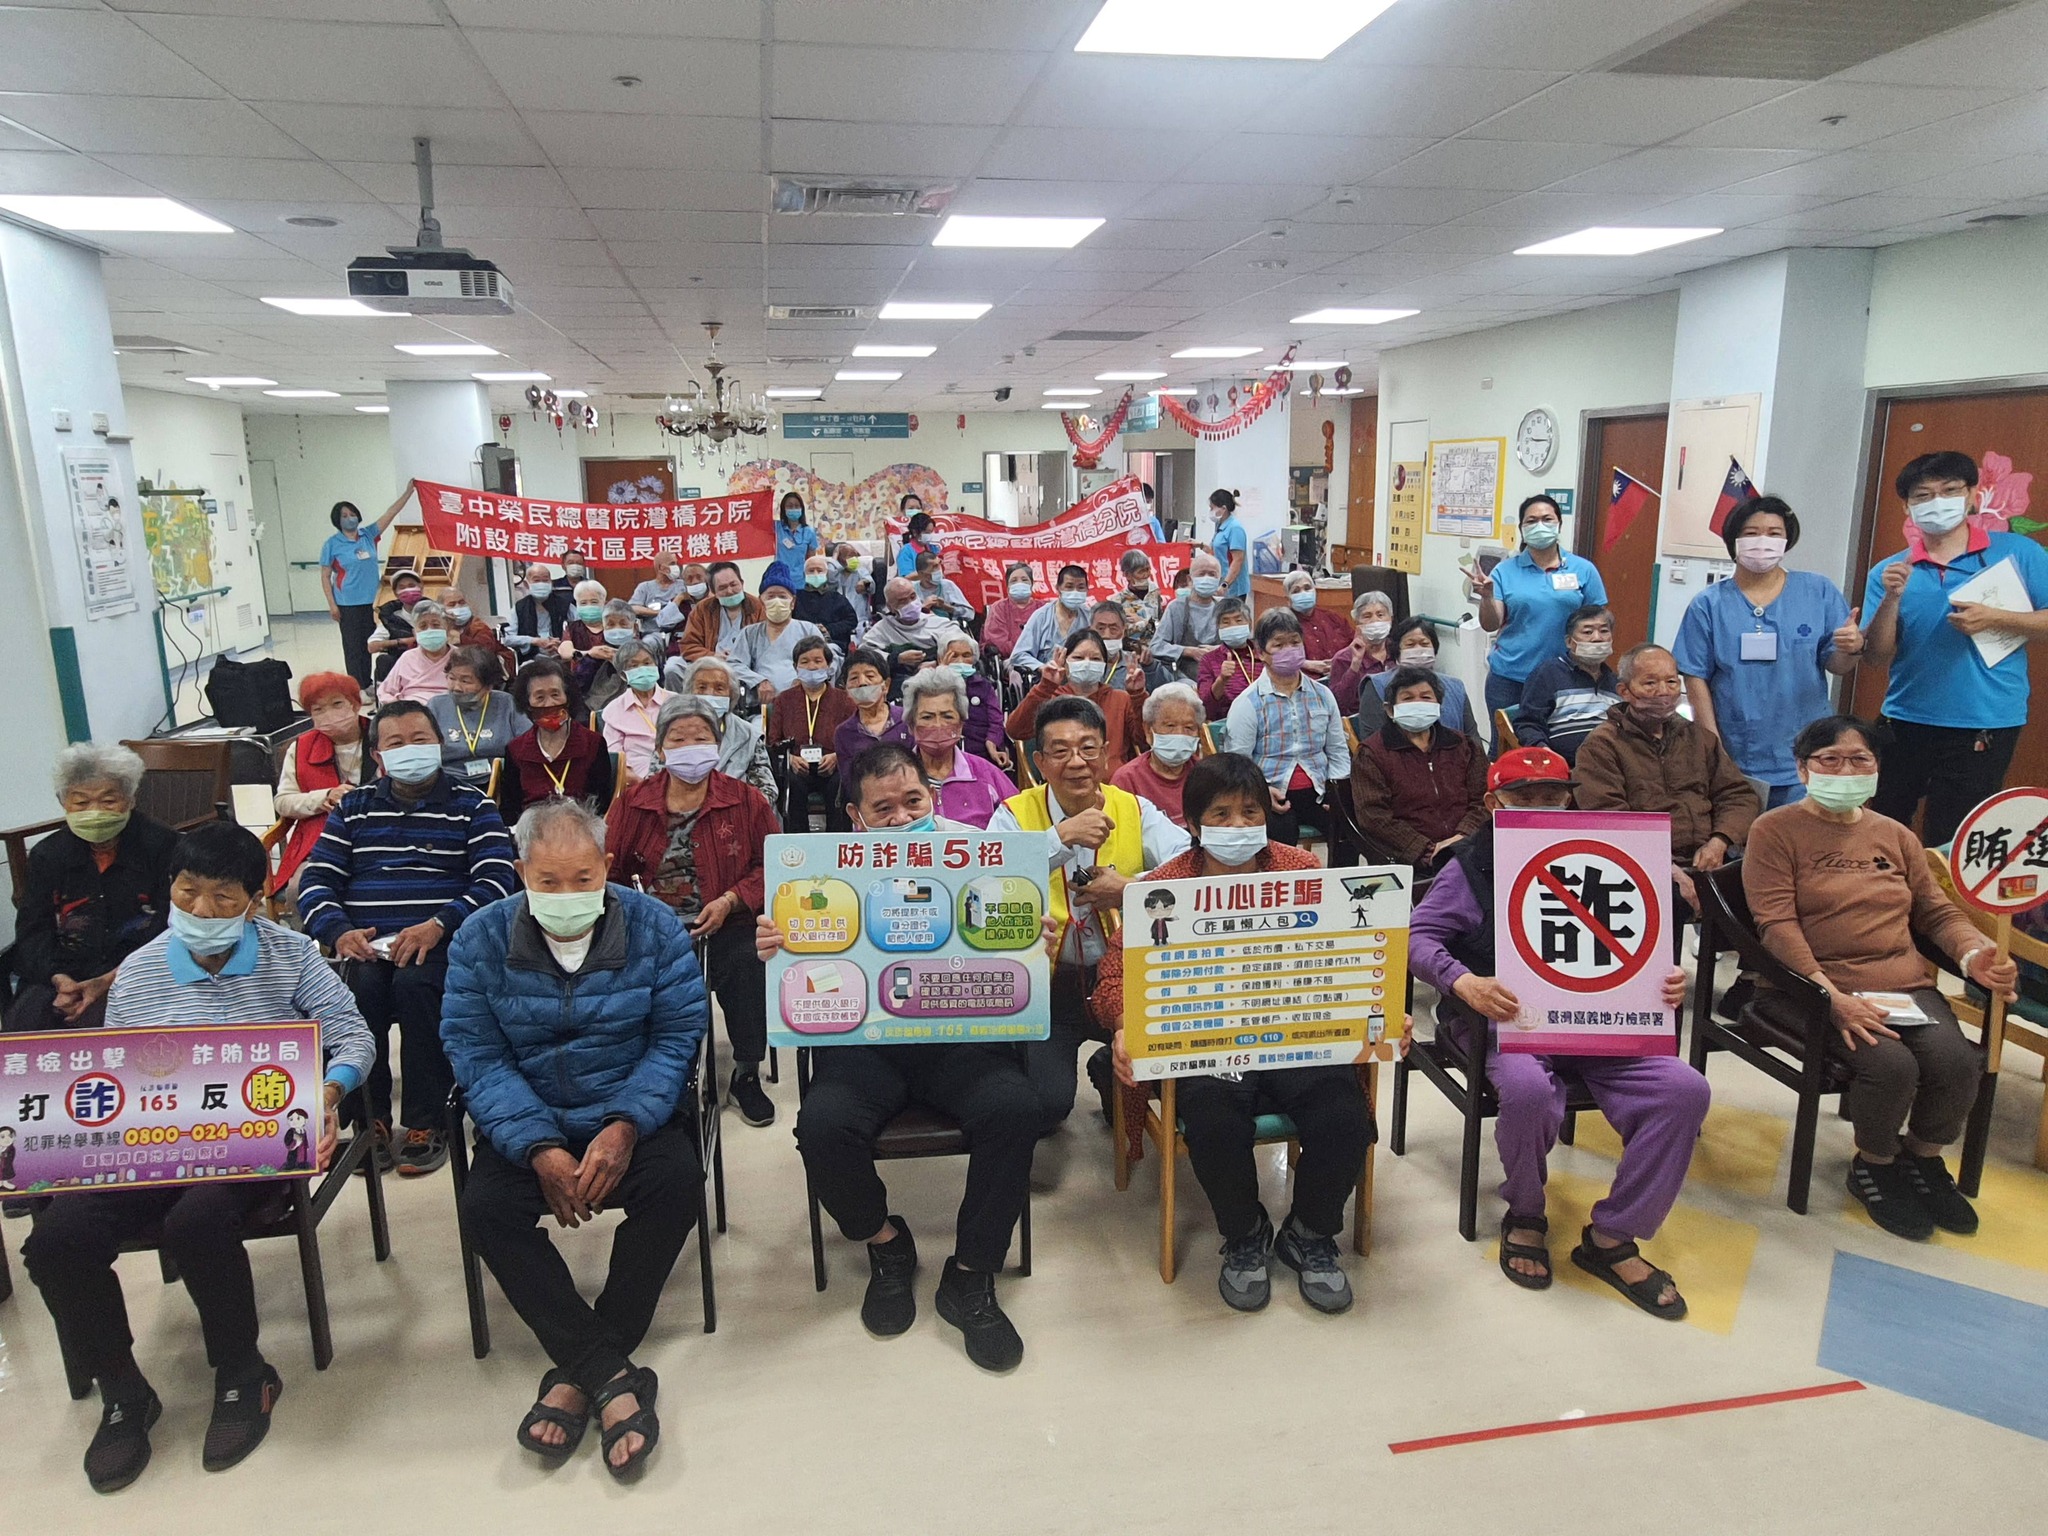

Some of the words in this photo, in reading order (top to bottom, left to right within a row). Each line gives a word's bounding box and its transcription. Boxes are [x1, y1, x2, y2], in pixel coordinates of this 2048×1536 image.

[438, 490, 752, 530] 臺中榮民總醫院灣橋分院
[456, 522, 738, 561] 附設鹿滿社區長照機構
[837, 839, 1004, 869] 防詐騙5招
[1194, 878, 1322, 912] 小心詐騙
[789, 918, 846, 929] 切勿提供
[1205, 916, 1289, 933] 詐騙懶人包
[1537, 865, 1636, 967] 詐
[1161, 965, 1224, 979] 解除分期付款
[793, 999, 859, 1010] 不提供個人銀行
[1547, 1010, 1664, 1027] 臺灣嘉義地方檢察署
[1239, 1035, 1255, 1044] 165
[1263, 1034, 1278, 1042] 110
[3, 1047, 126, 1076] 嘉檢出擊
[191, 1041, 300, 1065] 詐賄出局
[1226, 1054, 1250, 1066] 165
[140, 1094, 178, 1112] 165
[24, 1131, 121, 1152] 犯罪檢舉專線
[124, 1119, 280, 1147] 0800-024-099
